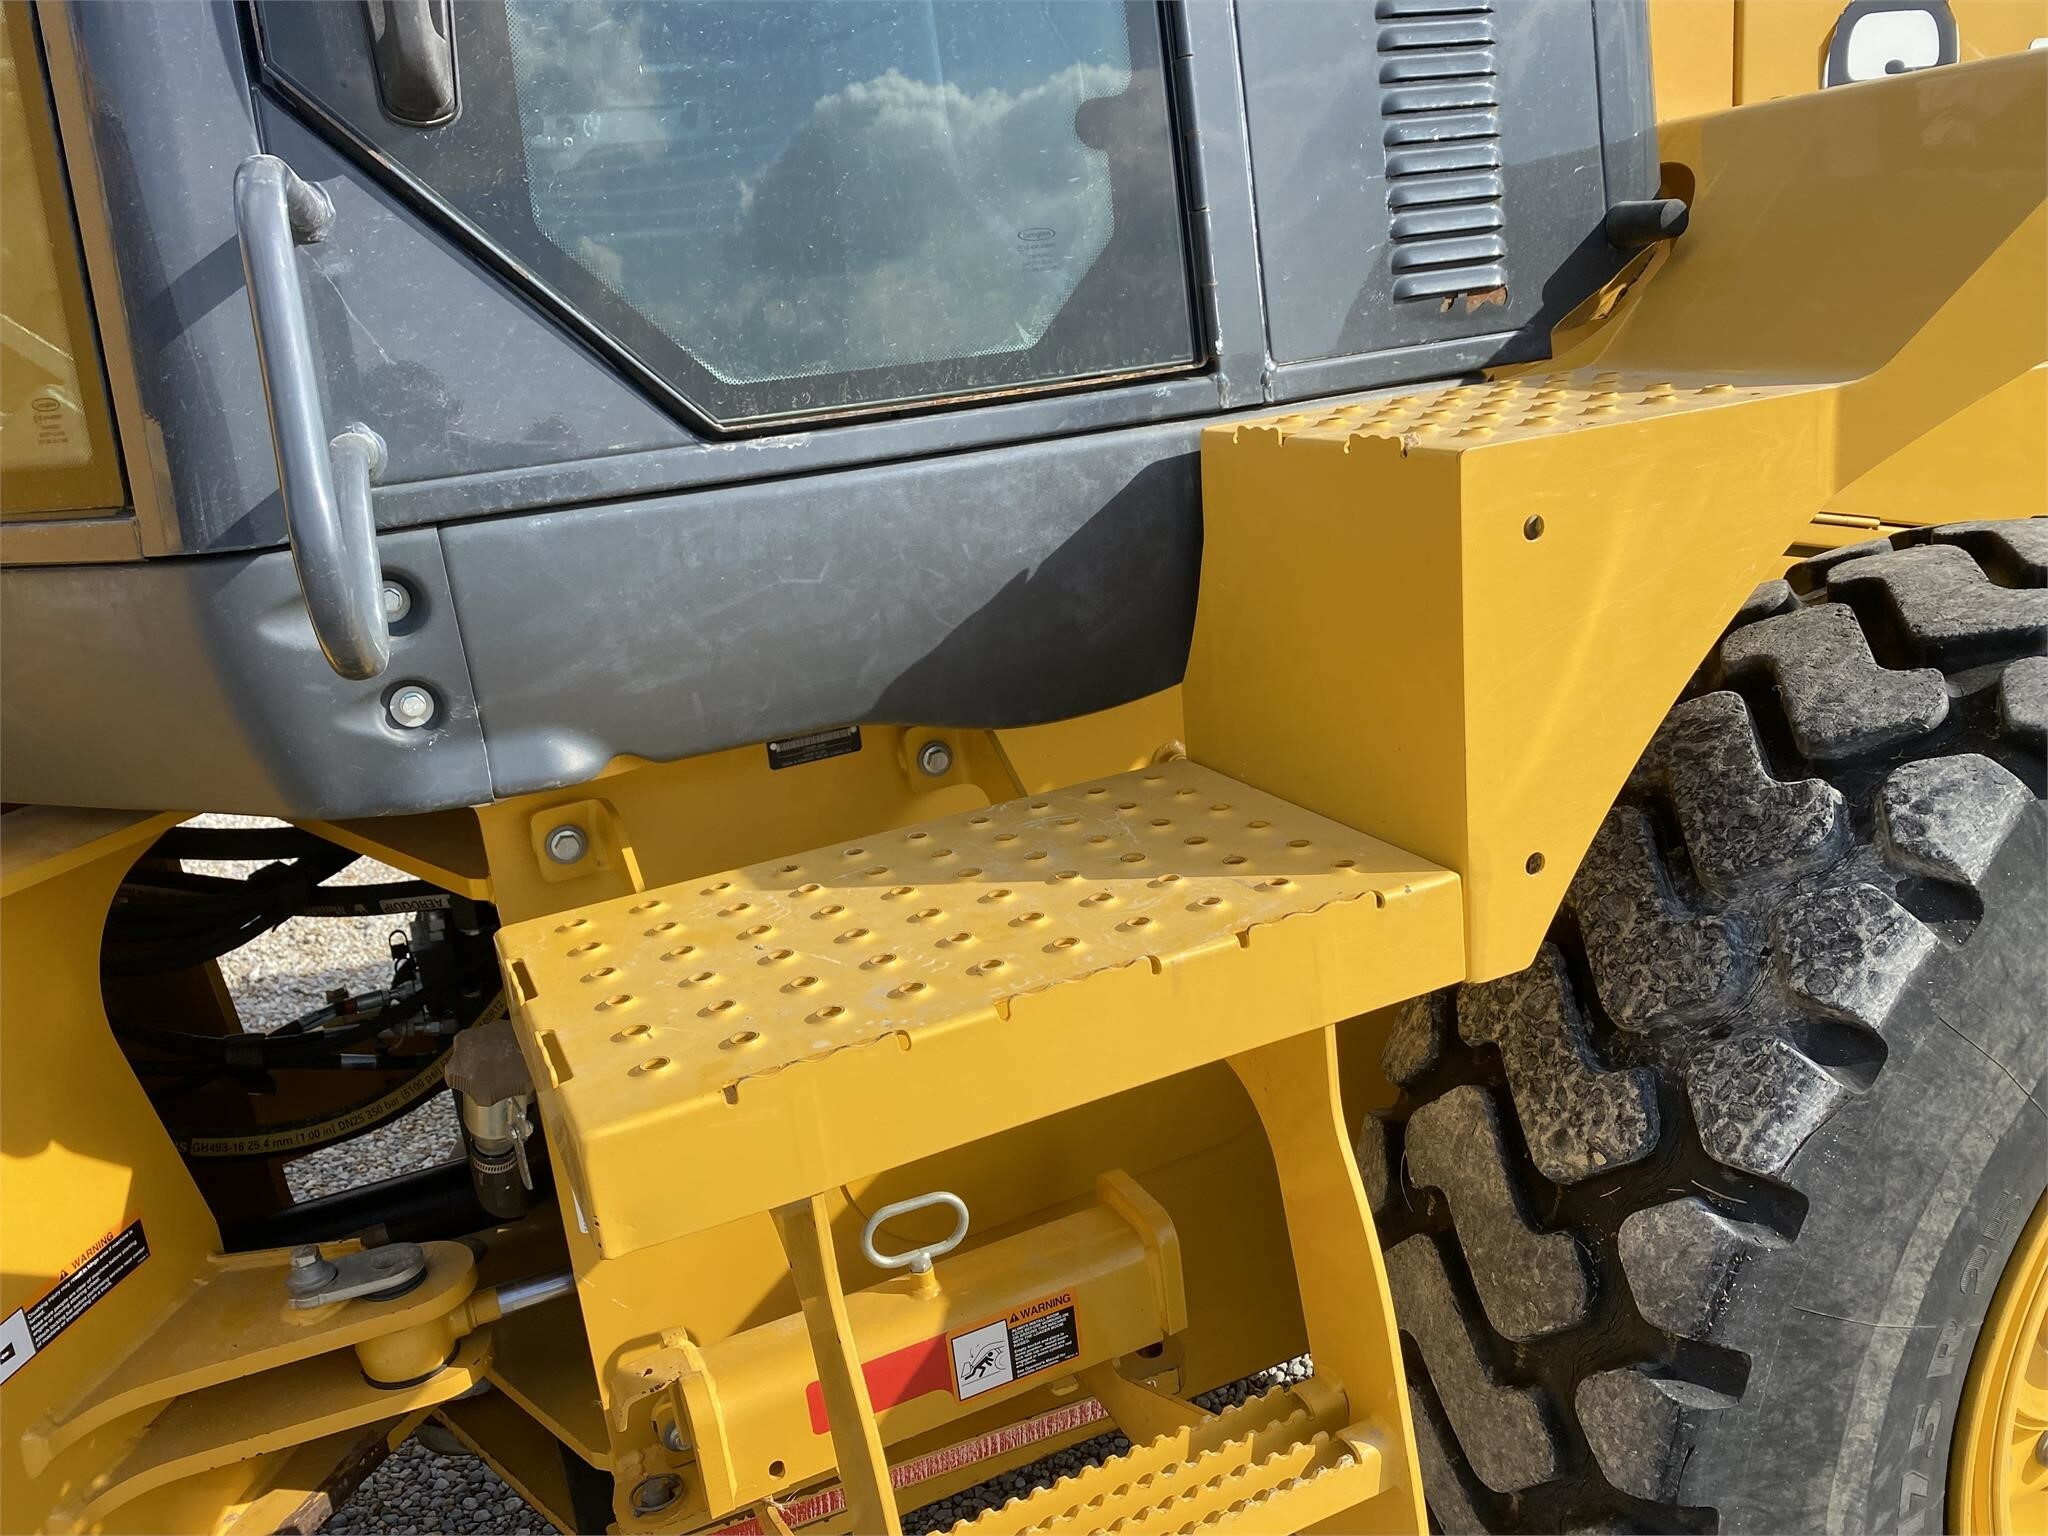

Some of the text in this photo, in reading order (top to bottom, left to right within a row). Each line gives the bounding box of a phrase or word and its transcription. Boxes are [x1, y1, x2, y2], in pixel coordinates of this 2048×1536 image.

[384, 899, 443, 912] AEROQUIP
[272, 1136, 293, 1147] mm
[338, 1115, 364, 1129] DN25
[367, 1106, 384, 1120] 350
[385, 1097, 401, 1110] bar
[401, 1078, 425, 1100] (5100
[71, 1231, 114, 1270] WARNING
[27, 1299, 48, 1320] Crushing
[47, 1289, 60, 1303] injury
[70, 1270, 83, 1284] result
[87, 1256, 99, 1270] hinge
[111, 1232, 128, 1250] machine
[30, 1317, 43, 1331] Make
[43, 1309, 53, 1321] sure
[53, 1296, 68, 1312] people
[75, 1281, 86, 1294] clear
[91, 1263, 109, 1281] machine
[108, 1252, 122, 1266] before
[121, 1239, 137, 1255] starting
[1926, 1320, 1966, 1378] R
[1959, 1189, 2022, 1296] 25
[32, 1320, 48, 1337] engine
[53, 1301, 70, 1319] moving
[69, 1287, 87, 1305] steering
[34, 1326, 49, 1342] Attach
[49, 1313, 65, 1330] locking
[72, 1295, 87, 1310] before
[86, 1276, 109, 1298] performing
[109, 1264, 124, 1280] service
[41, 1323, 60, 1343] machine
[65, 1298, 91, 1323] transporting
[1020, 1293, 1072, 1320] WARNING
[1024, 1322, 1040, 1331] BEFORE
[1041, 1314, 1062, 1325] WORKING
[1028, 1317, 1045, 1326] INSTALL
[1047, 1317, 1066, 1327] MACHINE
[1033, 1327, 1050, 1336] LOADER
